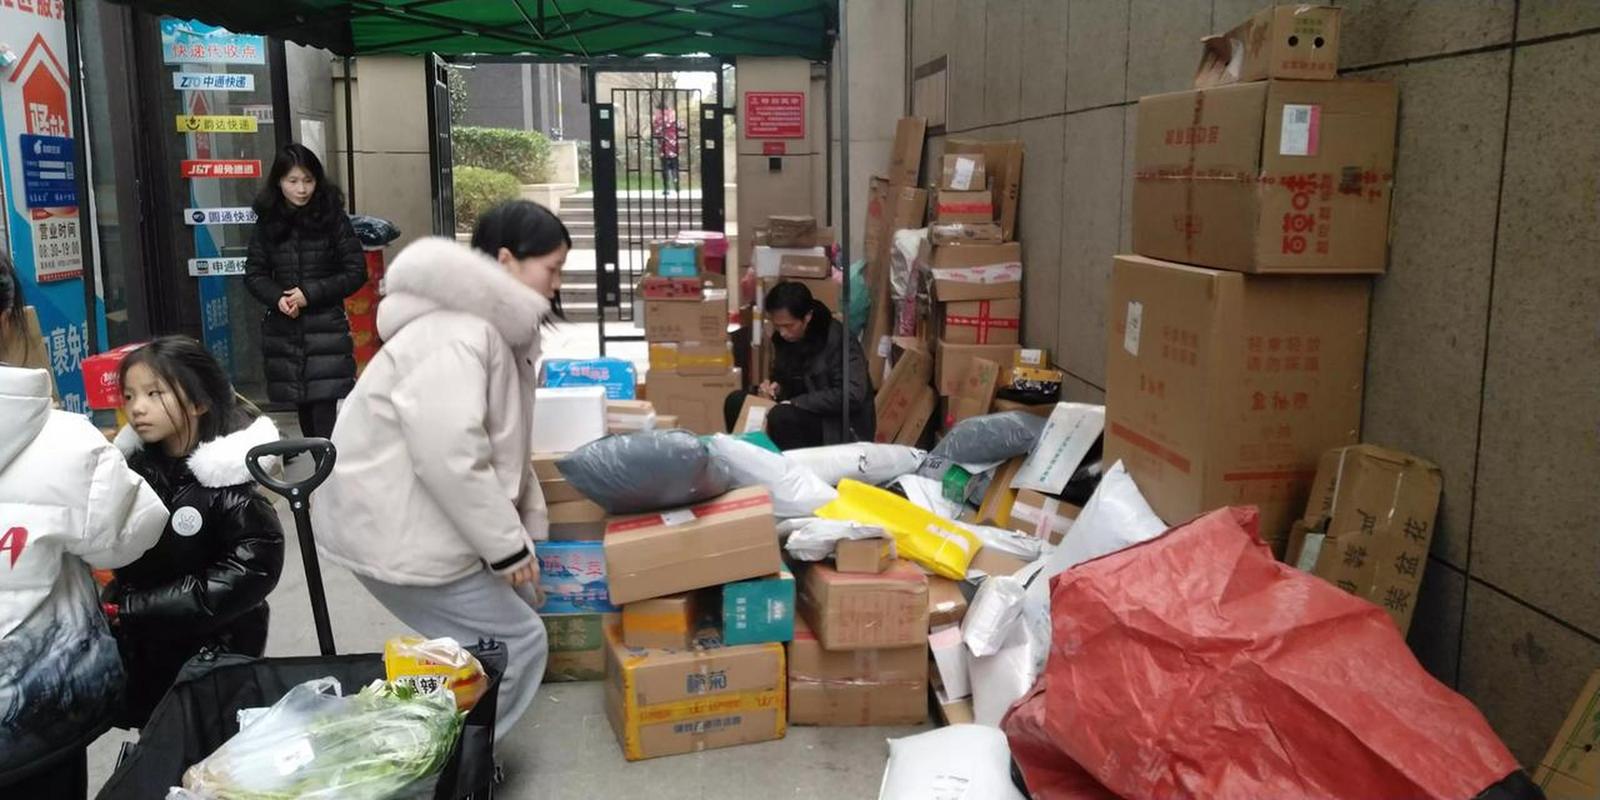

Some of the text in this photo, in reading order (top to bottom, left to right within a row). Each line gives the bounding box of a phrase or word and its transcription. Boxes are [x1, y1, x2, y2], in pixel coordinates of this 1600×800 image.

[172, 44, 257, 58] 快递代收点
[180, 75, 247, 88] ZTO 中通快递
[203, 120, 251, 130] 韵达快递
[188, 164, 254, 174] J&T 极兔速递
[208, 209, 258, 223] 圆通快递
[39, 222, 76, 240] 营业时间
